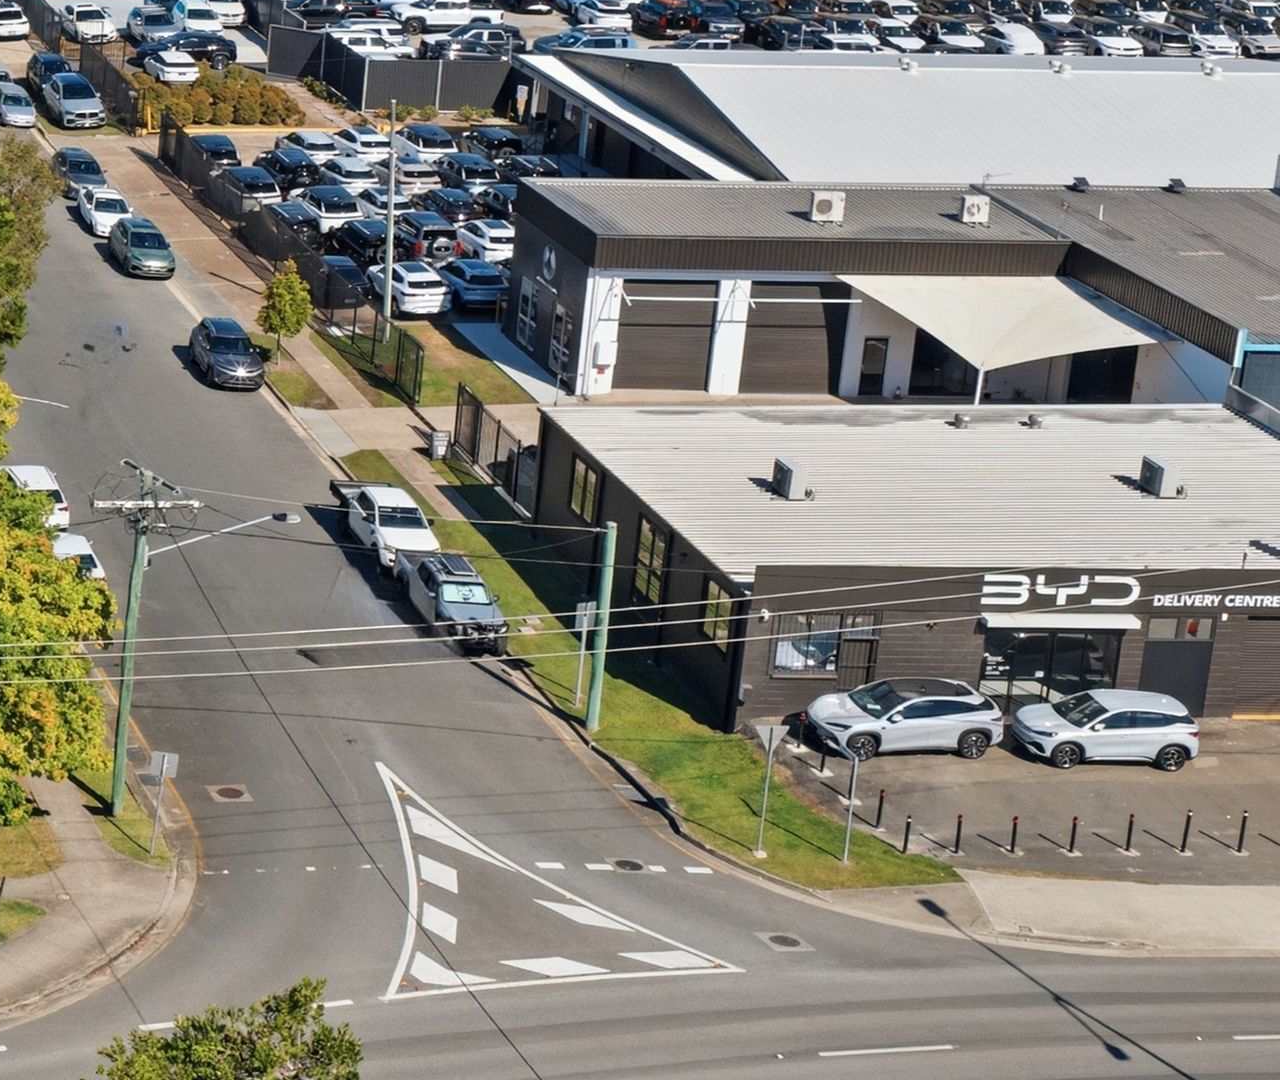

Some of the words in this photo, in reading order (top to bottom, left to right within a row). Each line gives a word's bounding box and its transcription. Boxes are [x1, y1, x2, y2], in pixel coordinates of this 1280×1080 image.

[980, 574, 1141, 606] BYD
[1153, 594, 1222, 607] DELIVERY
[1224, 594, 1280, 607] CENTRE
